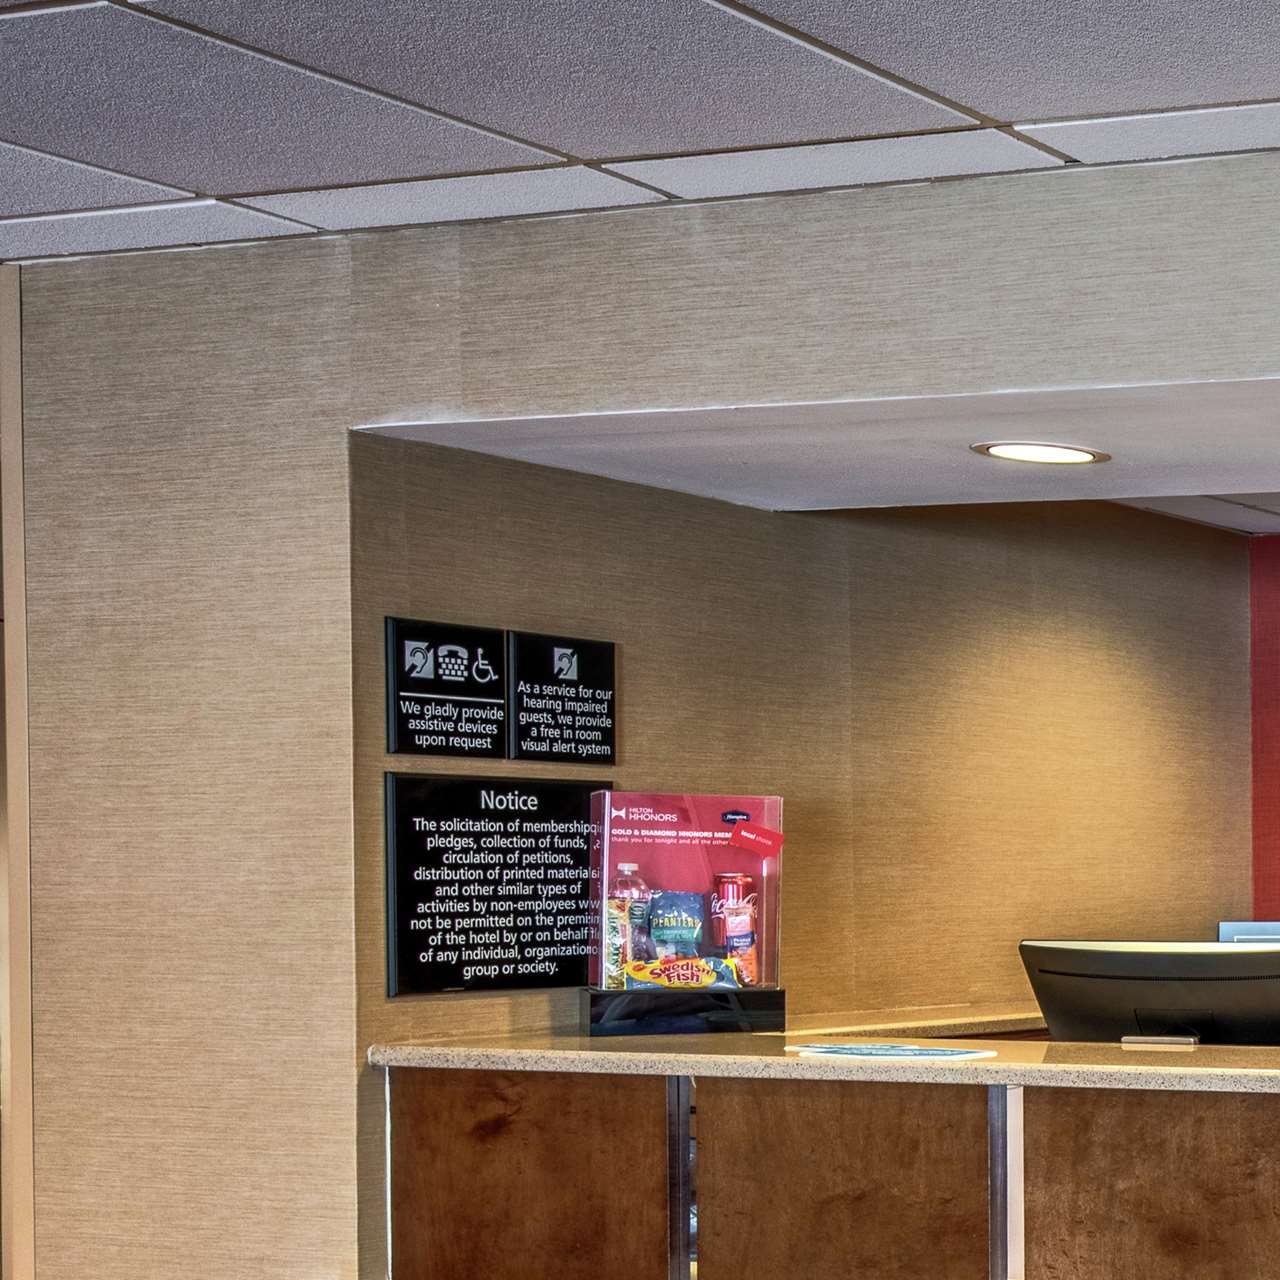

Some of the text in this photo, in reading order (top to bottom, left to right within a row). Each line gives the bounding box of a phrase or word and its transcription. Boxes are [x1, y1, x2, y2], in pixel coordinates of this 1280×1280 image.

[518, 681, 612, 699] As a service for our
[401, 701, 504, 722] We gladly provide
[524, 695, 607, 714] hearing impaired
[409, 718, 497, 734] assistive devices
[520, 712, 611, 728] guests, we provide
[531, 725, 601, 740] a free in room
[416, 734, 492, 749] upon request
[521, 739, 610, 757] visual alert system
[481, 790, 538, 810] Notice
[413, 818, 436, 831] The
[440, 819, 503, 832] solicitation
[507, 819, 519, 832] of
[427, 834, 587, 850] pledges, collection of funds,
[443, 851, 573, 866] circulation of petitions,
[414, 867, 484, 880] distribution
[487, 868, 500, 880] of
[504, 867, 544, 883] printed
[435, 883, 582, 897] and other similar types of
[417, 901, 470, 913] activities
[473, 899, 487, 914] by
[491, 898, 576, 913] non-employees
[411, 912, 589, 932] not be permitted on the premi
[429, 928, 588, 946] of the hotel by or on behalf
[420, 949, 433, 962] of
[436, 950, 458, 964] any
[462, 946, 521, 961] individual,
[463, 961, 558, 979] group or society.
[649, 962, 712, 979] Swedish
[664, 971, 701, 983] Fish
